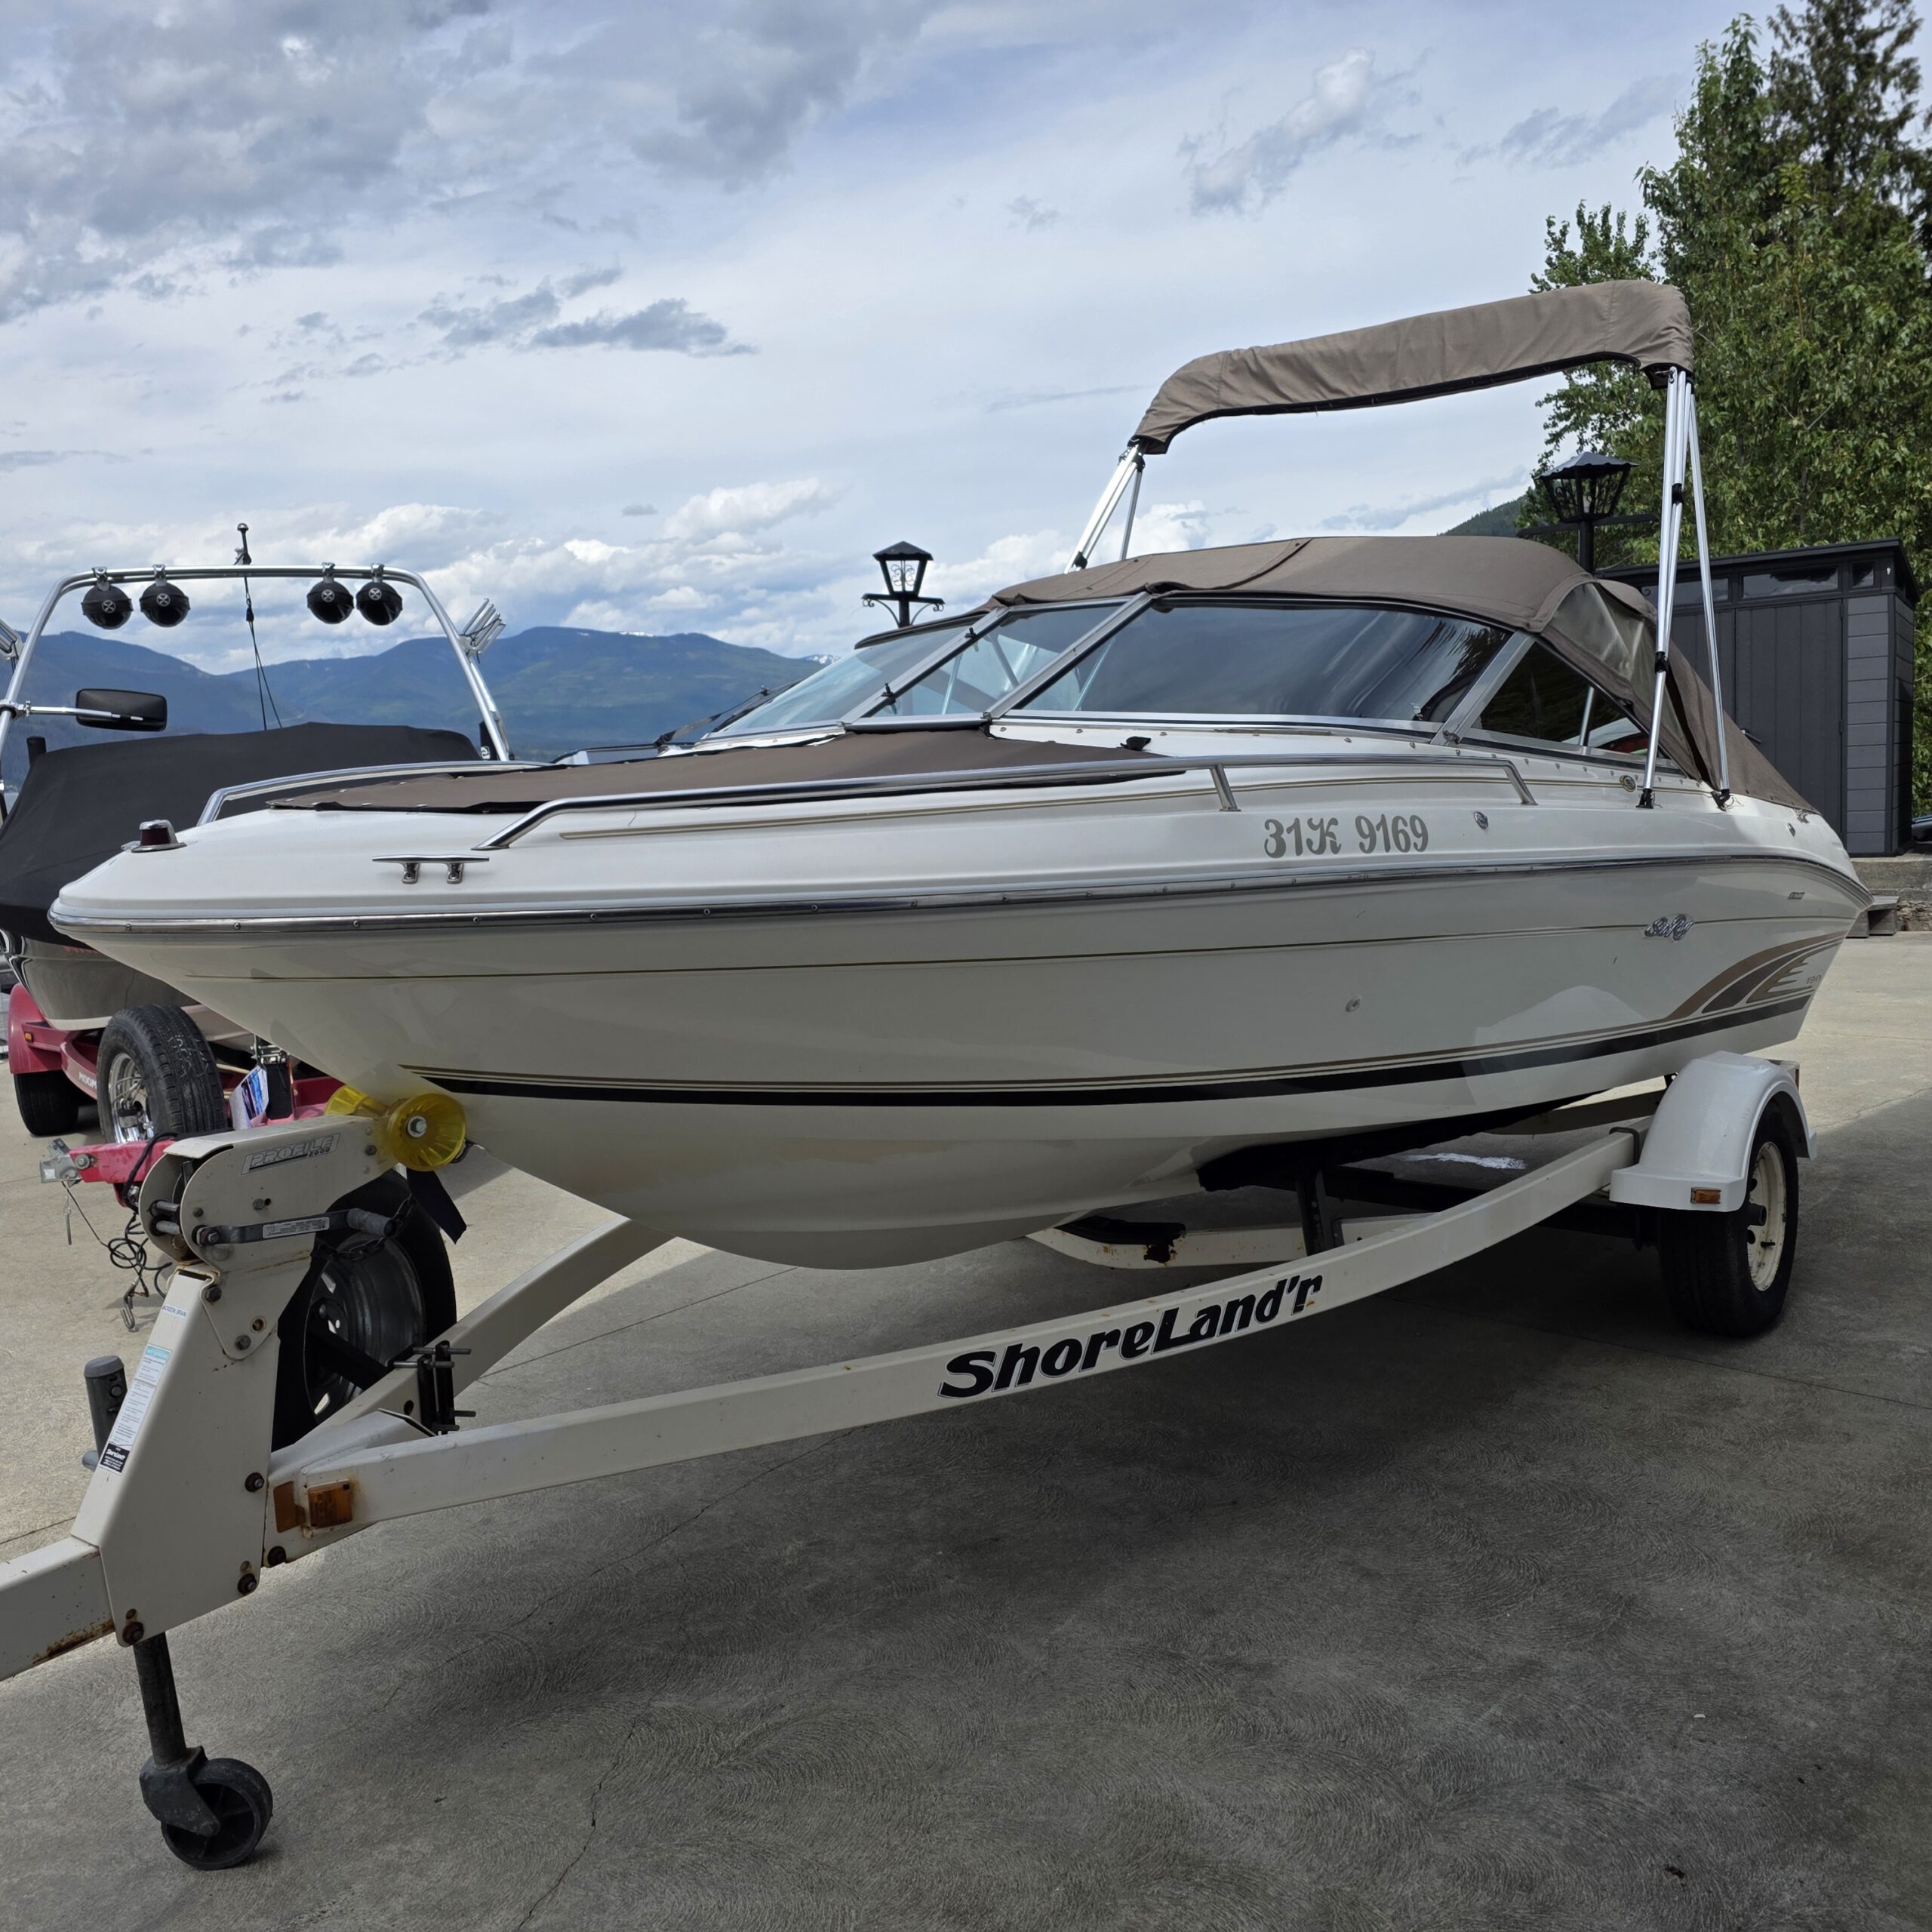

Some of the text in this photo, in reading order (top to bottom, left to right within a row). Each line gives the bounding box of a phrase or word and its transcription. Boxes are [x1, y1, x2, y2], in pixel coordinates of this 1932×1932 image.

[1264, 814, 1429, 859] 31K 9169
[250, 1135, 334, 1168] PROFILE
[937, 1275, 1323, 1398] ShoreLand'r
